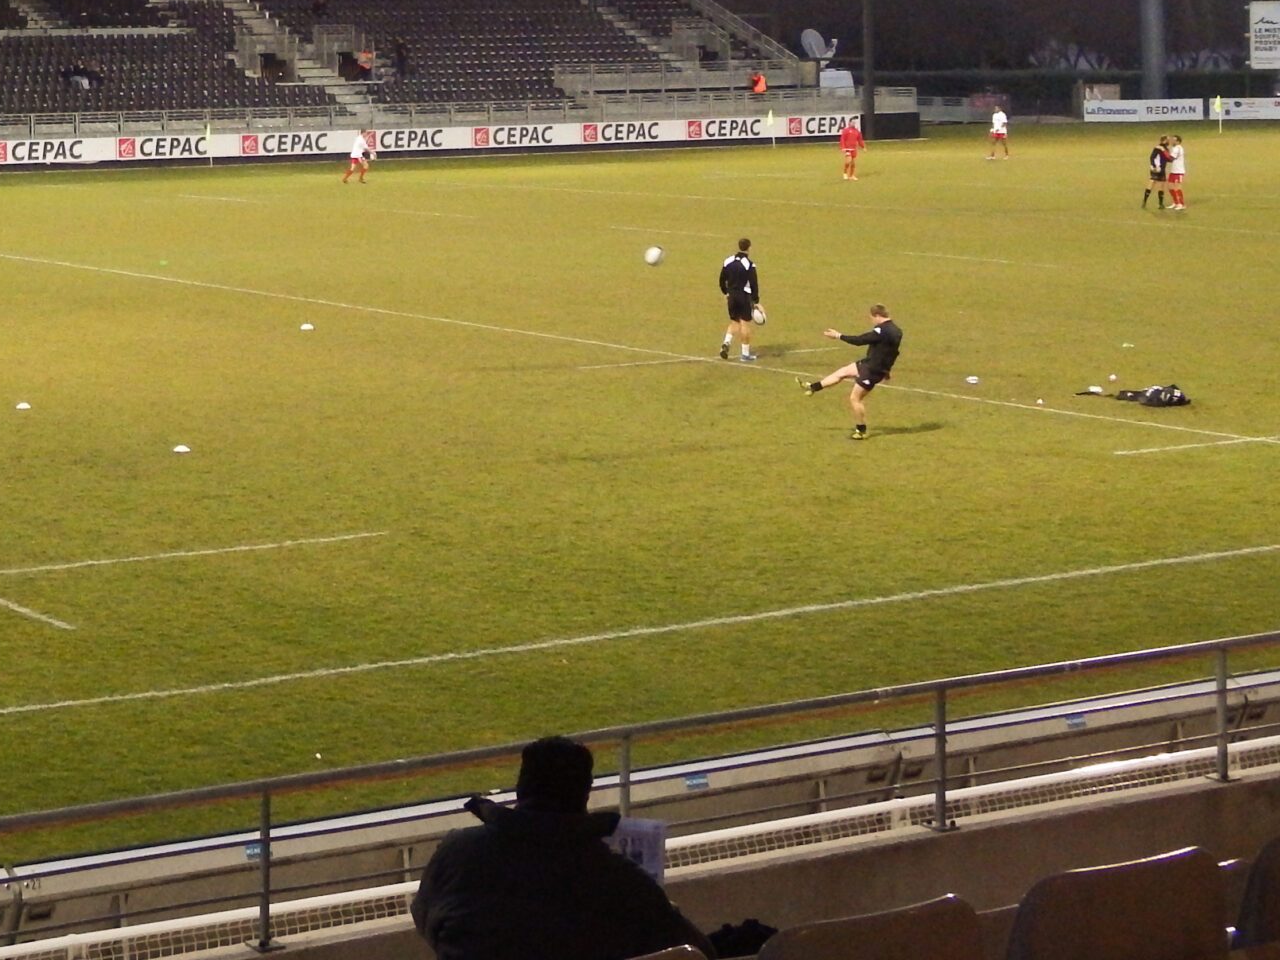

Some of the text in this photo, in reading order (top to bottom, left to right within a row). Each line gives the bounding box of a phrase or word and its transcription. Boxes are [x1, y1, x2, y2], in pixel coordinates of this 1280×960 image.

[1085, 106, 1138, 115] La Provence
[1146, 106, 1196, 115] REDMAN
[493, 126, 552, 145] CEPAC
[602, 122, 658, 141] CEPAC
[706, 119, 760, 137] CEPAC
[140, 137, 207, 157] CEPAC
[263, 133, 327, 153] CEPAC
[380, 130, 442, 149] CEPAC
[11, 140, 82, 161] CEPAC
